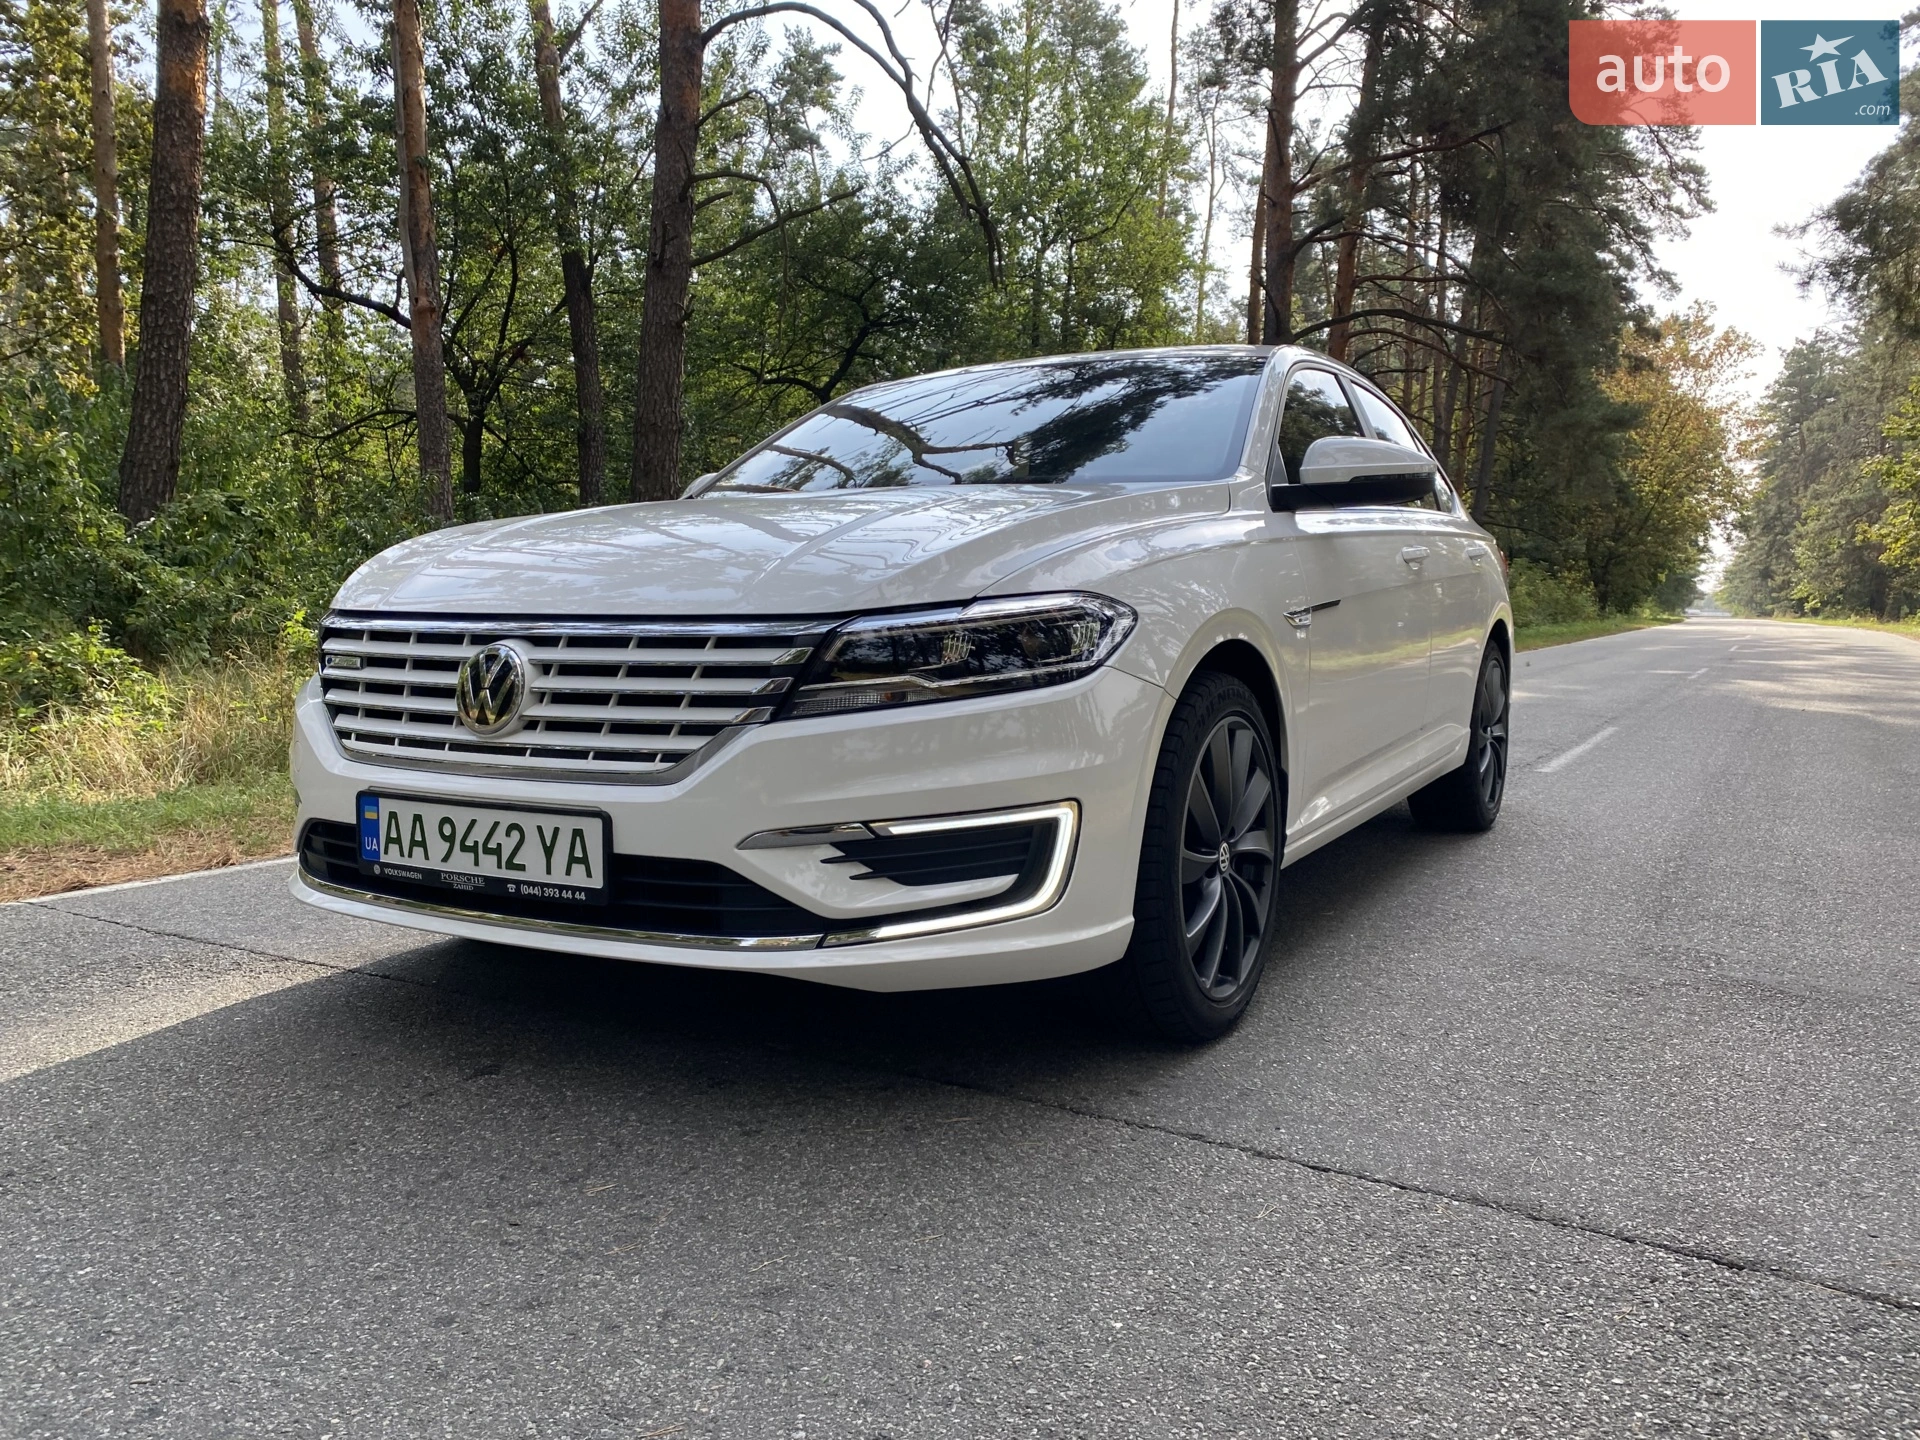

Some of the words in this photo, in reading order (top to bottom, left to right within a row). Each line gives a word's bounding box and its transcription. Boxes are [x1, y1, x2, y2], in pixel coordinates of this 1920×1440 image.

[364, 836, 379, 852] UA
[383, 810, 430, 861] AA
[437, 815, 527, 872] 9442
[536, 824, 593, 879] YA
[383, 867, 423, 880] VOLKSWAGEN
[440, 872, 486, 885] PORSCHE
[520, 884, 542, 897] (044)
[543, 887, 560, 898] 393
[561, 889, 573, 899] 44
[574, 891, 586, 900] 44
